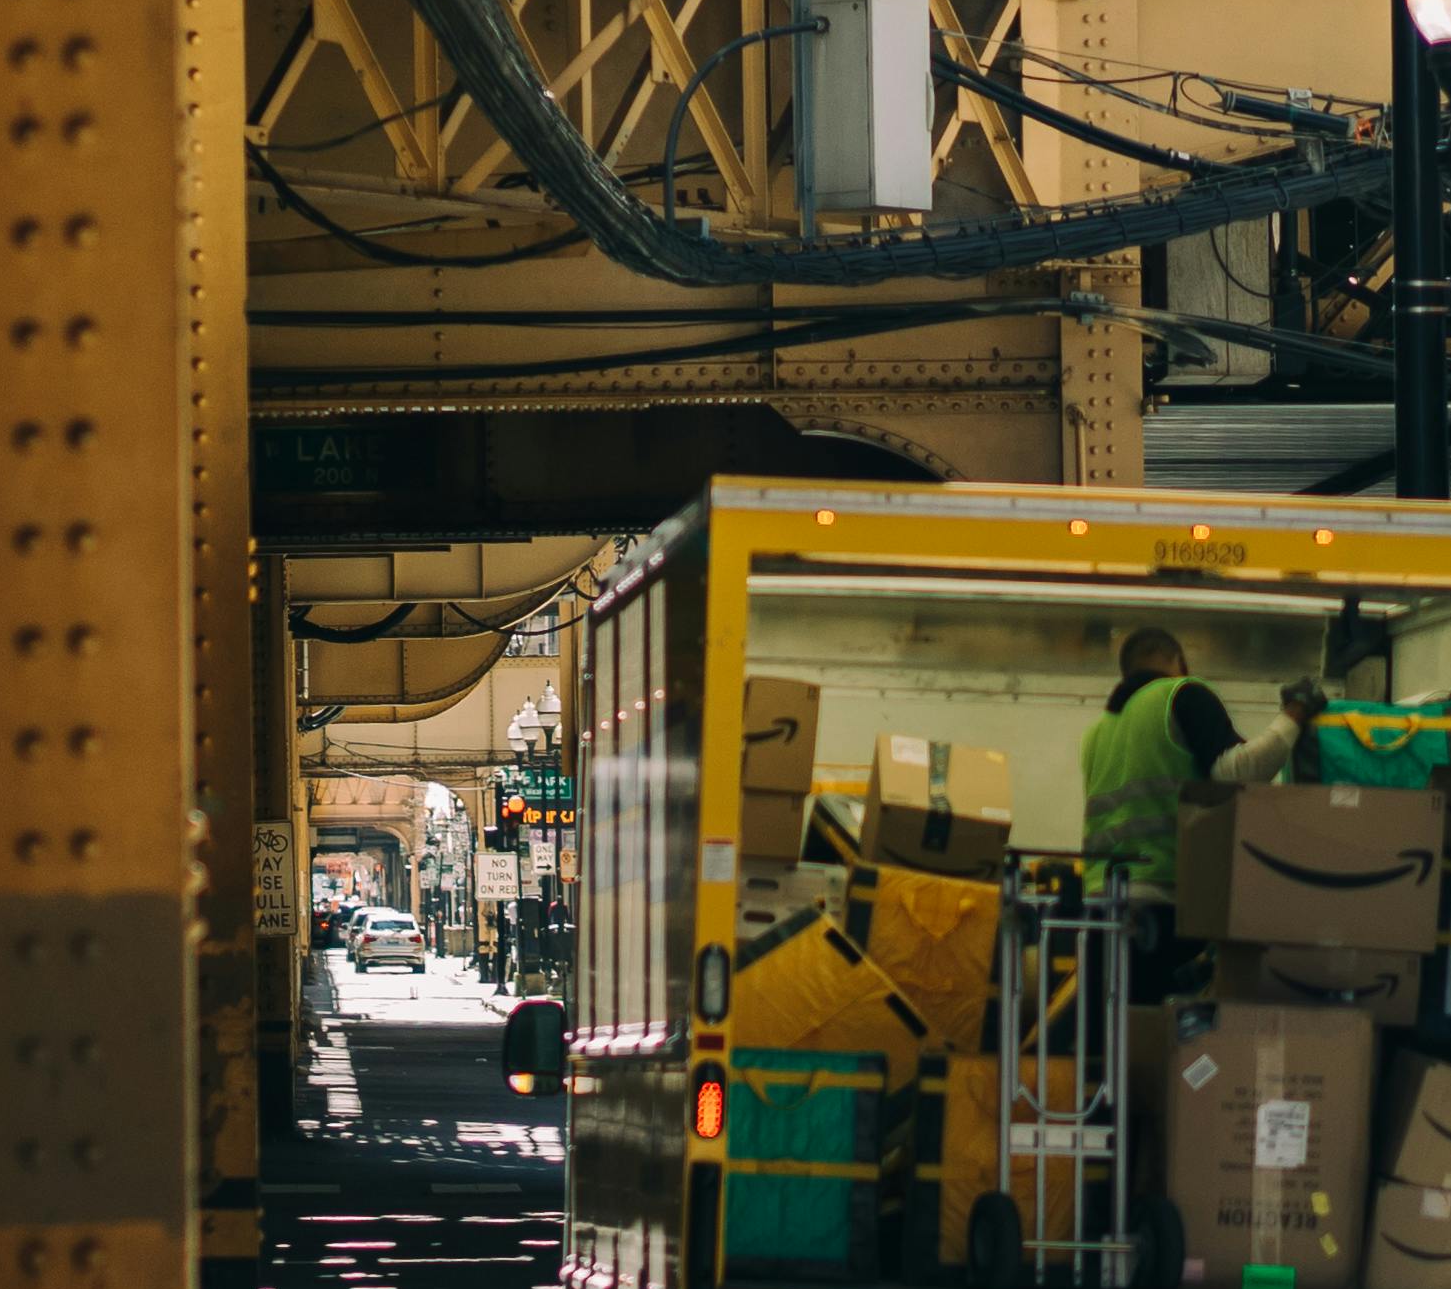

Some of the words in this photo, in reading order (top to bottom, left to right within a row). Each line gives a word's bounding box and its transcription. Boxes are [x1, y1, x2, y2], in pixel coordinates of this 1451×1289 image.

[298, 435, 380, 462] LAKE
[314, 467, 355, 485] 200
[536, 845, 554, 854] ONE
[256, 856, 283, 872] AY
[491, 859, 507, 868] NO
[536, 854, 554, 862] WAY
[486, 871, 513, 881] TURN
[480, 884, 495, 894] ON
[498, 885, 518, 894] RED
[256, 893, 291, 910] ULL
[257, 912, 291, 929] ANE
